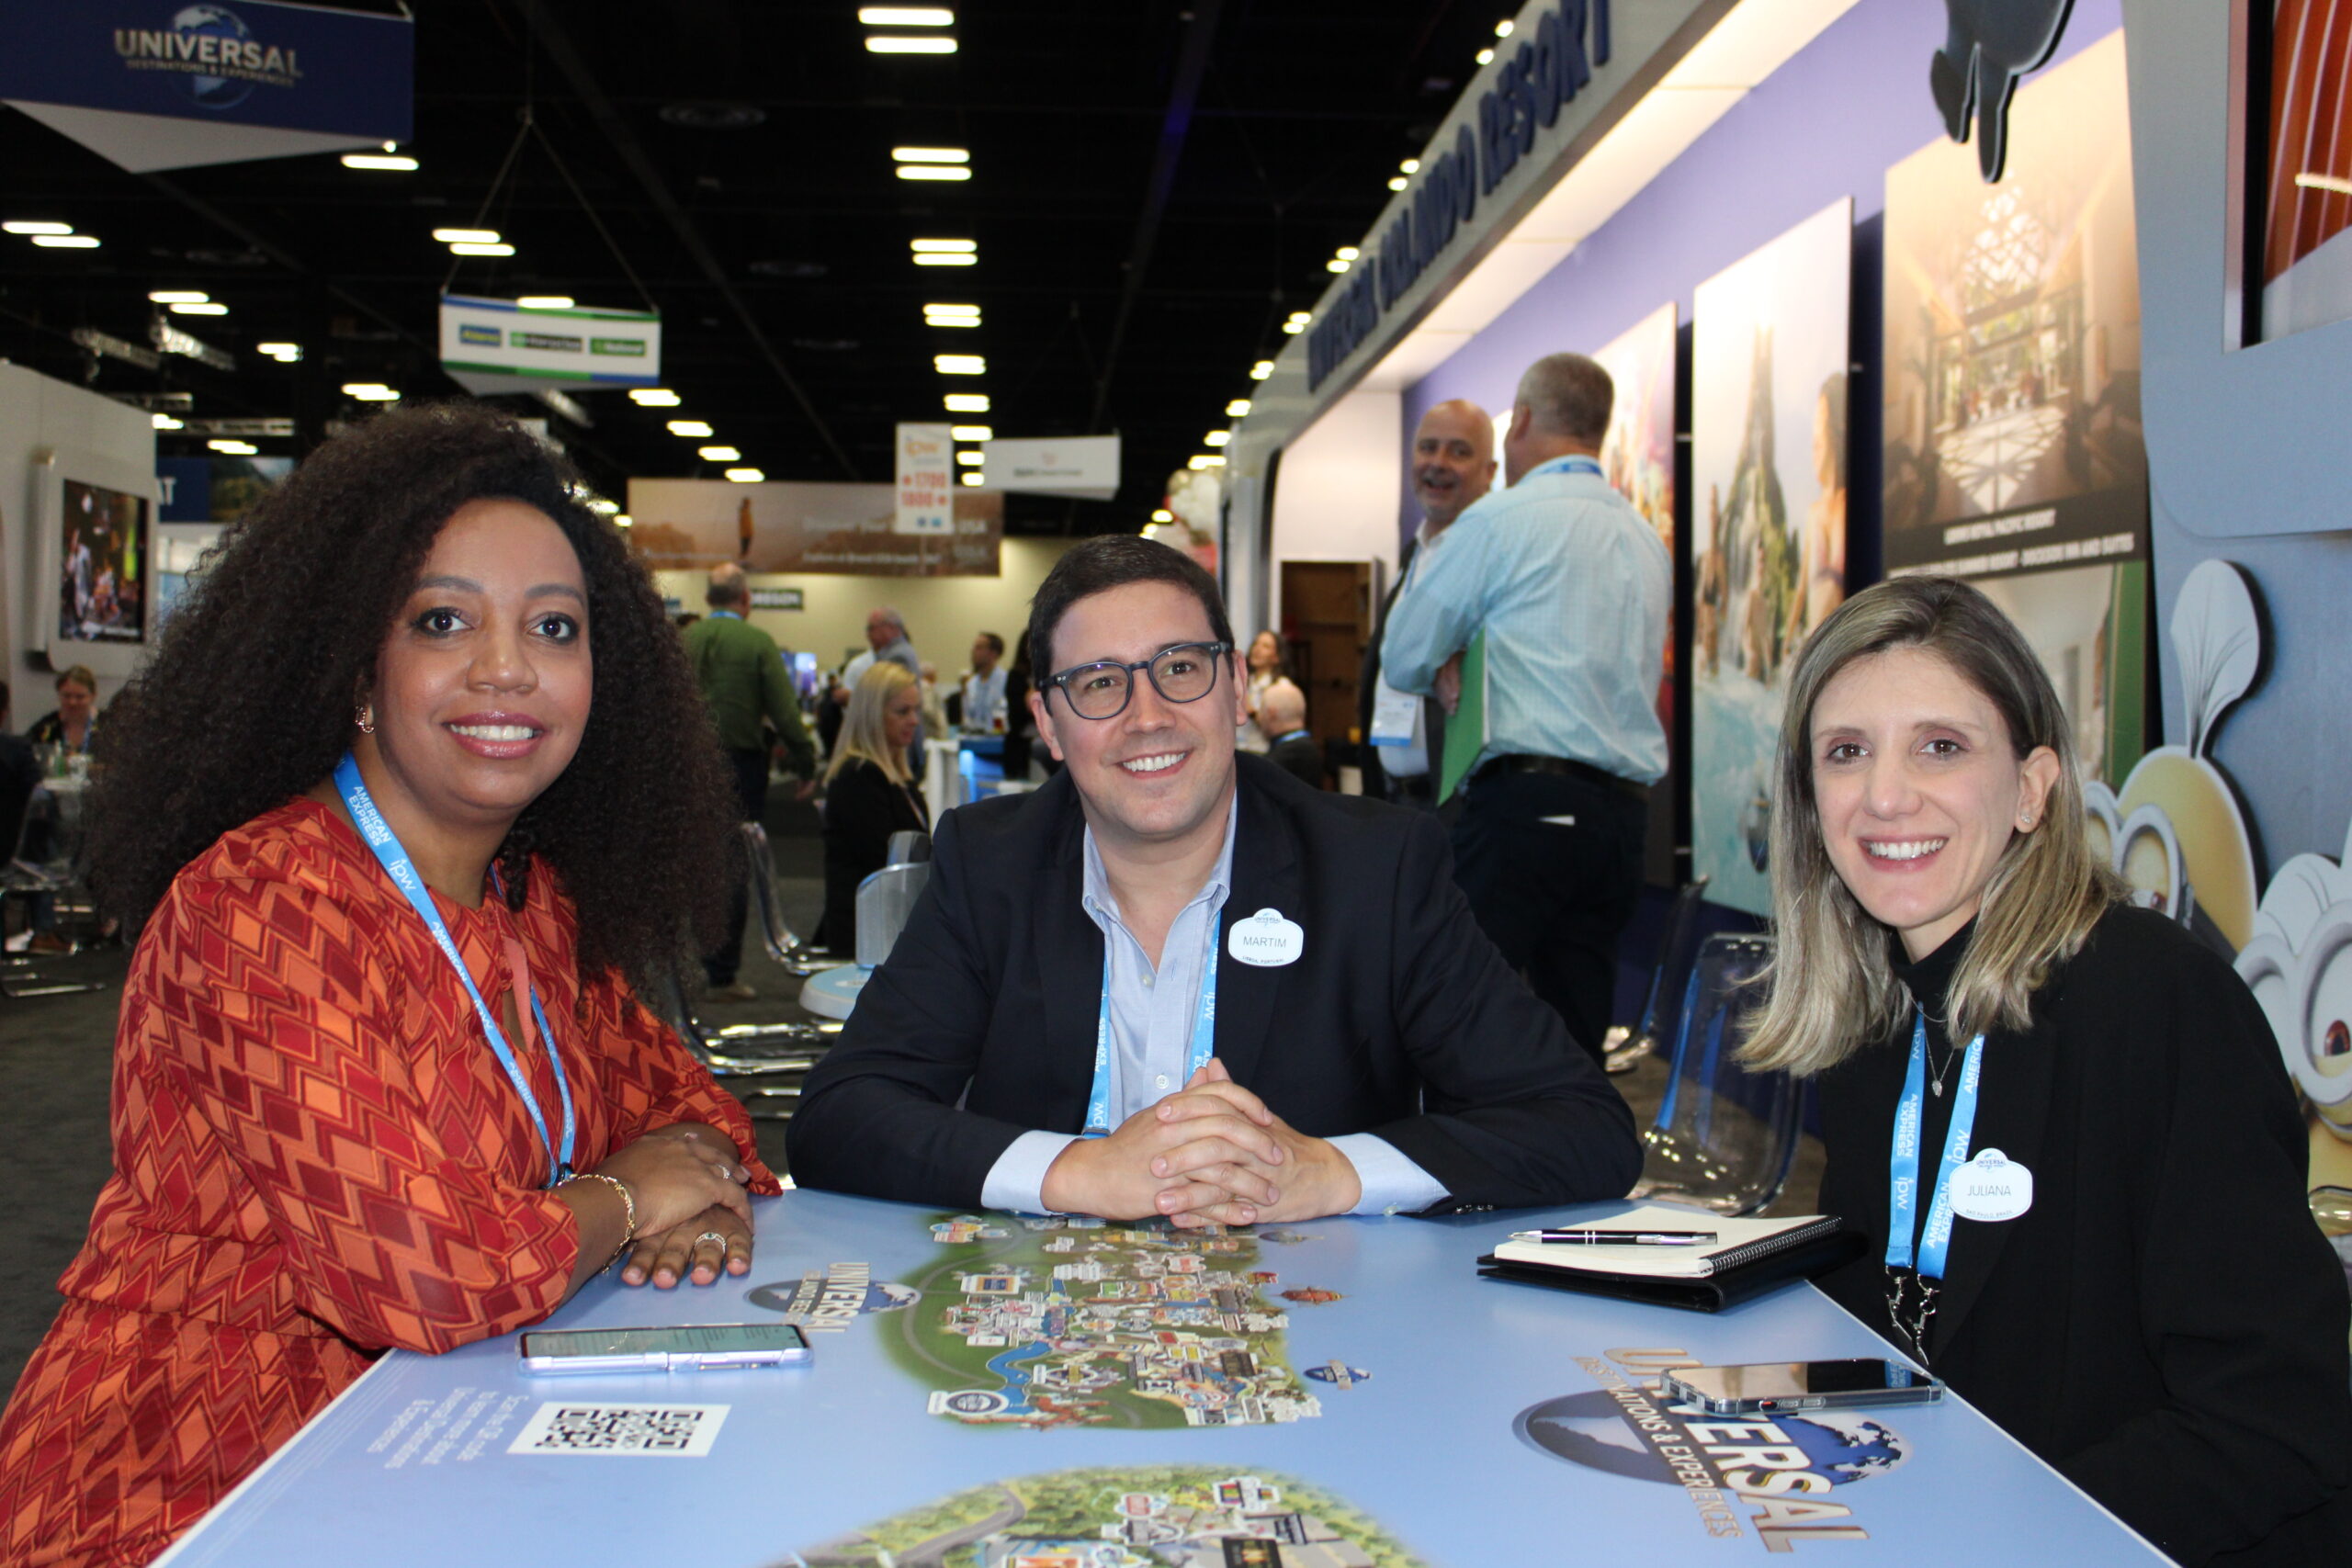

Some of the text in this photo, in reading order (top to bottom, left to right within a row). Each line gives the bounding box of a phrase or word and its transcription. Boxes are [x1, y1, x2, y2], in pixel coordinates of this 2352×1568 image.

[114, 28, 299, 77] UNIVERSAL
[126, 58, 206, 73] DESTINATIONS
[220, 67, 295, 86] EXPERIENCES
[1479, 0, 1611, 197] RESORT
[349, 795, 383, 846] EXPRESS
[354, 786, 392, 843] AMERICAN
[389, 858, 416, 890] ipw
[432, 920, 468, 982] AMERICAN
[1243, 935, 1287, 948] MARTIM
[1896, 1100, 1909, 1157] EXPRESS
[1905, 1093, 1918, 1158] AMERICAN
[1945, 1129, 1971, 1166] ipw
[1897, 1176, 1915, 1211] ipw
[1926, 1180, 1950, 1249] AMERICAN
[1967, 1184, 2012, 1197] JULIANA
[804, 1261, 870, 1333] UNIVERSAL
[1569, 1356, 1743, 1539] DESTINATIONS & EXPERIENCES
